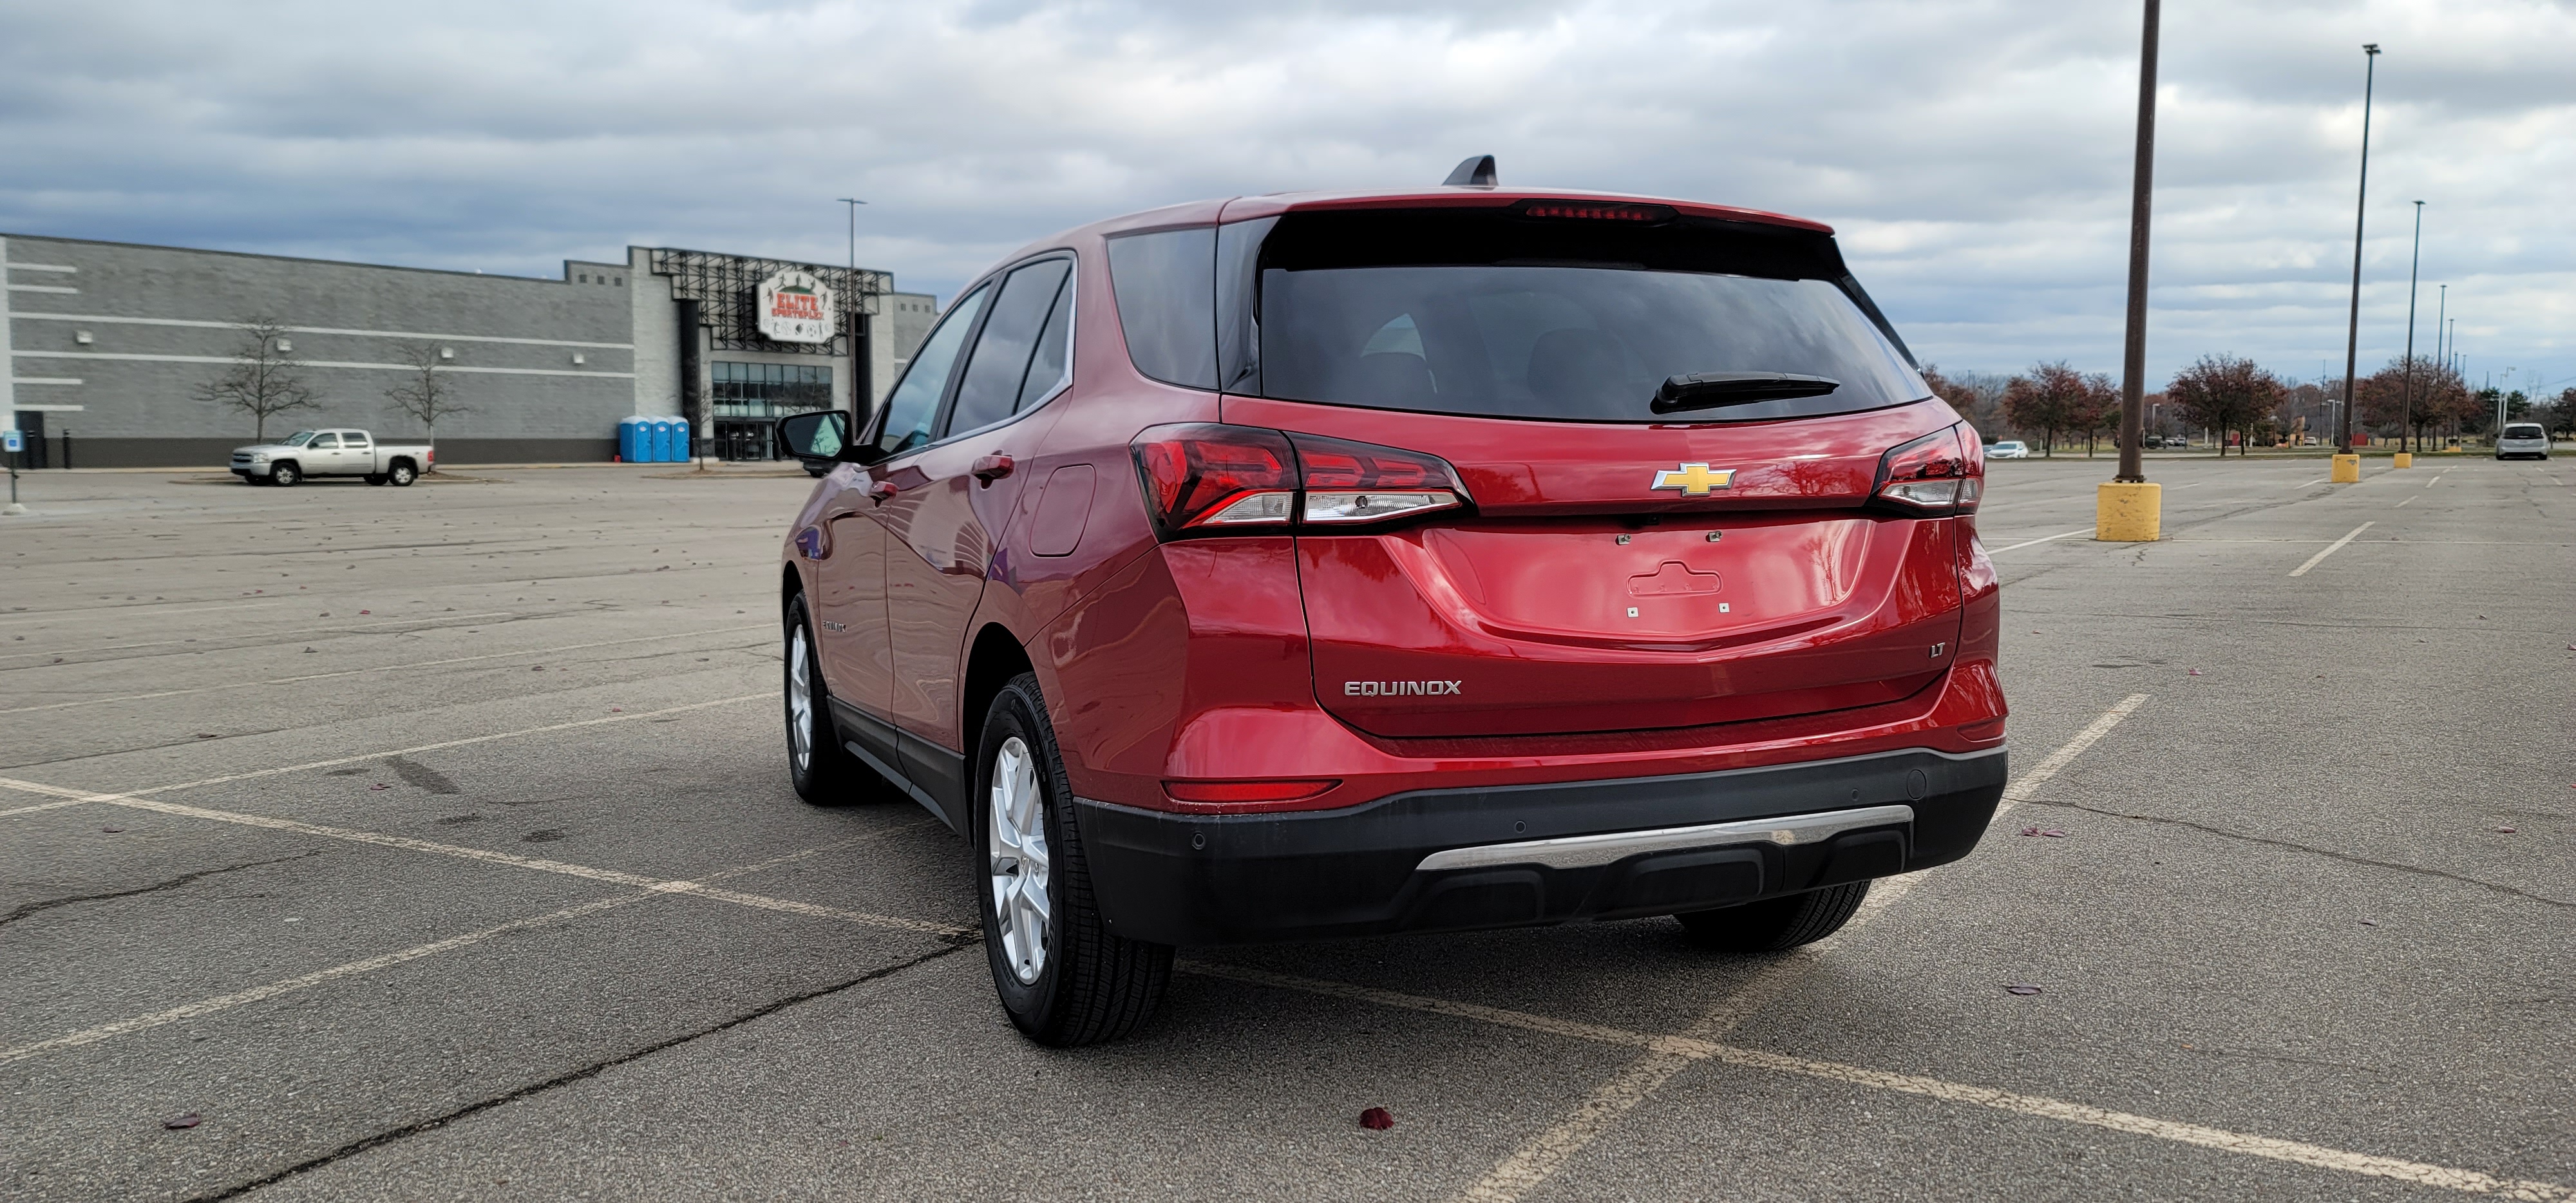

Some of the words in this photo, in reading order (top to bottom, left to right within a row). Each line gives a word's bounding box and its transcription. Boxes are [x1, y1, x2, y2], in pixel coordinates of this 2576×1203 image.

[777, 293, 818, 310] ELITE
[1931, 642, 1946, 658] LT
[1345, 680, 1461, 697] EQUINOX
